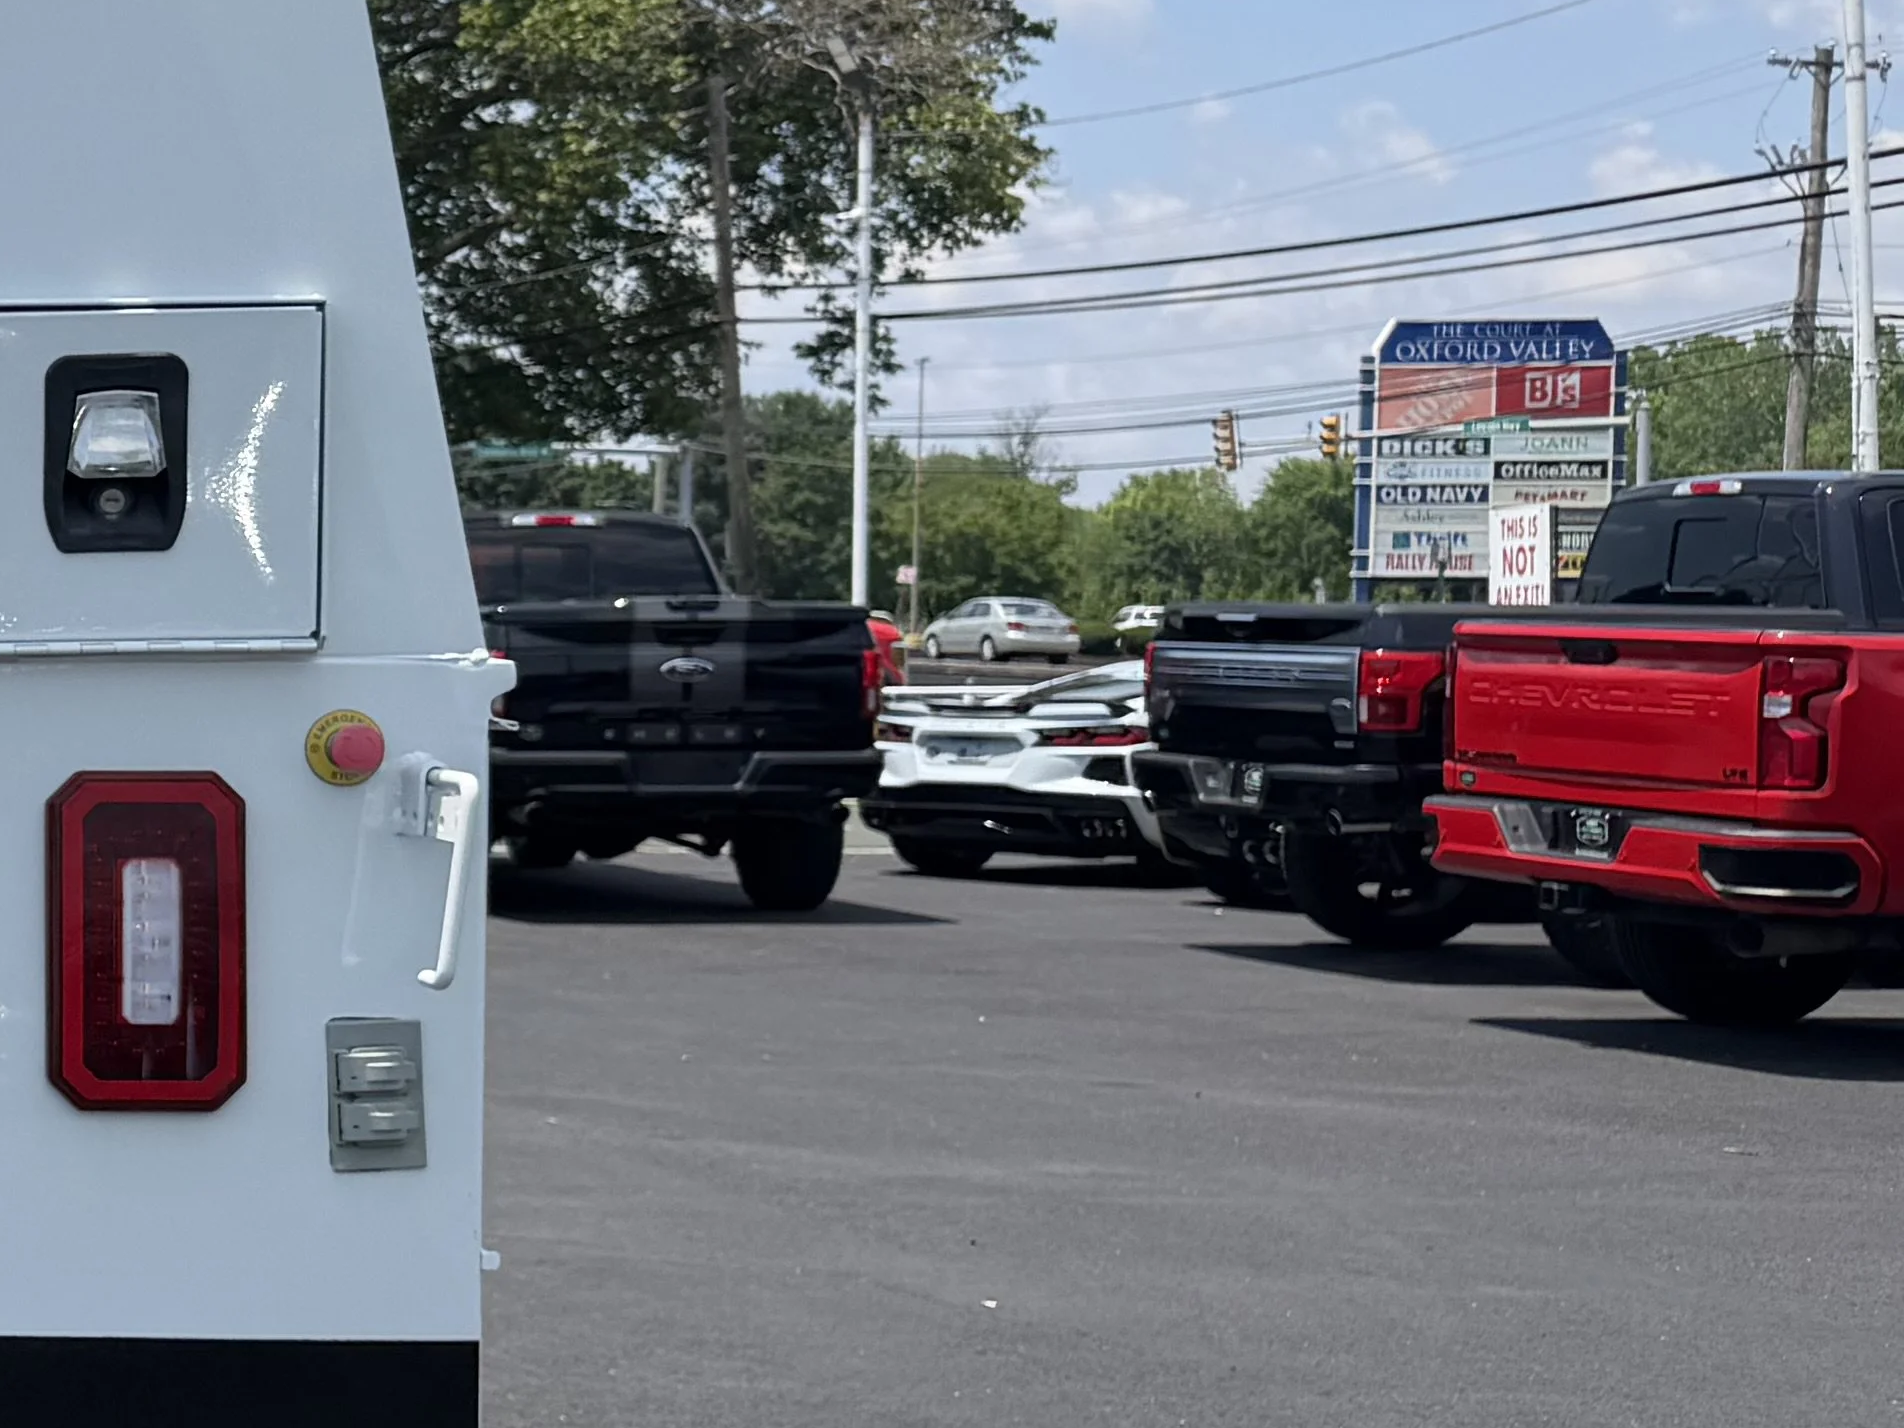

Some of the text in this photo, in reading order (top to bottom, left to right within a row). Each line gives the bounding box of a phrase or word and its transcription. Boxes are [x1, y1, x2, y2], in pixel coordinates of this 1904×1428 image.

[1433, 322, 1561, 338] THE COURT AT
[1396, 339, 1595, 362] OXFORD VALLEY
[1381, 439, 1485, 456] DICK'S
[1520, 435, 1589, 452] JOANN
[1501, 463, 1602, 480] OfficeMax
[1380, 486, 1483, 504] OLD NAVY
[1501, 518, 1525, 541] THIS
[1528, 514, 1539, 538] IS
[1386, 553, 1427, 571] RALLY
[1502, 545, 1536, 578] NOT
[1497, 583, 1544, 605] AN EXIT!
[1468, 681, 1732, 717] CHEVROLET
